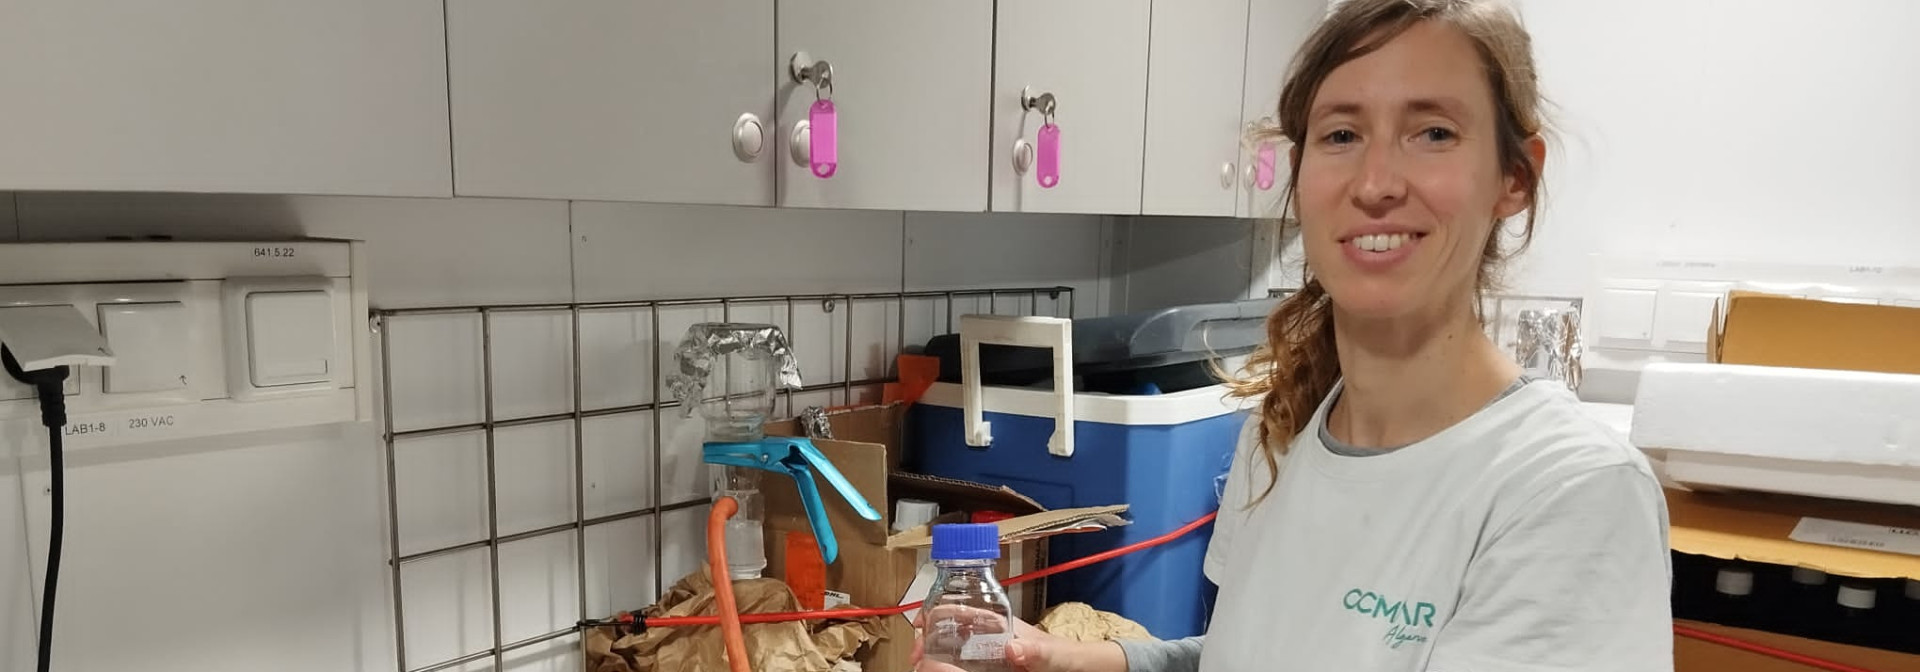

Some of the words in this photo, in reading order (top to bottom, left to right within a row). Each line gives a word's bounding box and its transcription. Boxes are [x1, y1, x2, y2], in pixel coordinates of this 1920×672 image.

[128, 418, 148, 428] 230
[151, 415, 174, 426] VAC
[65, 422, 106, 435] LAB1-8
